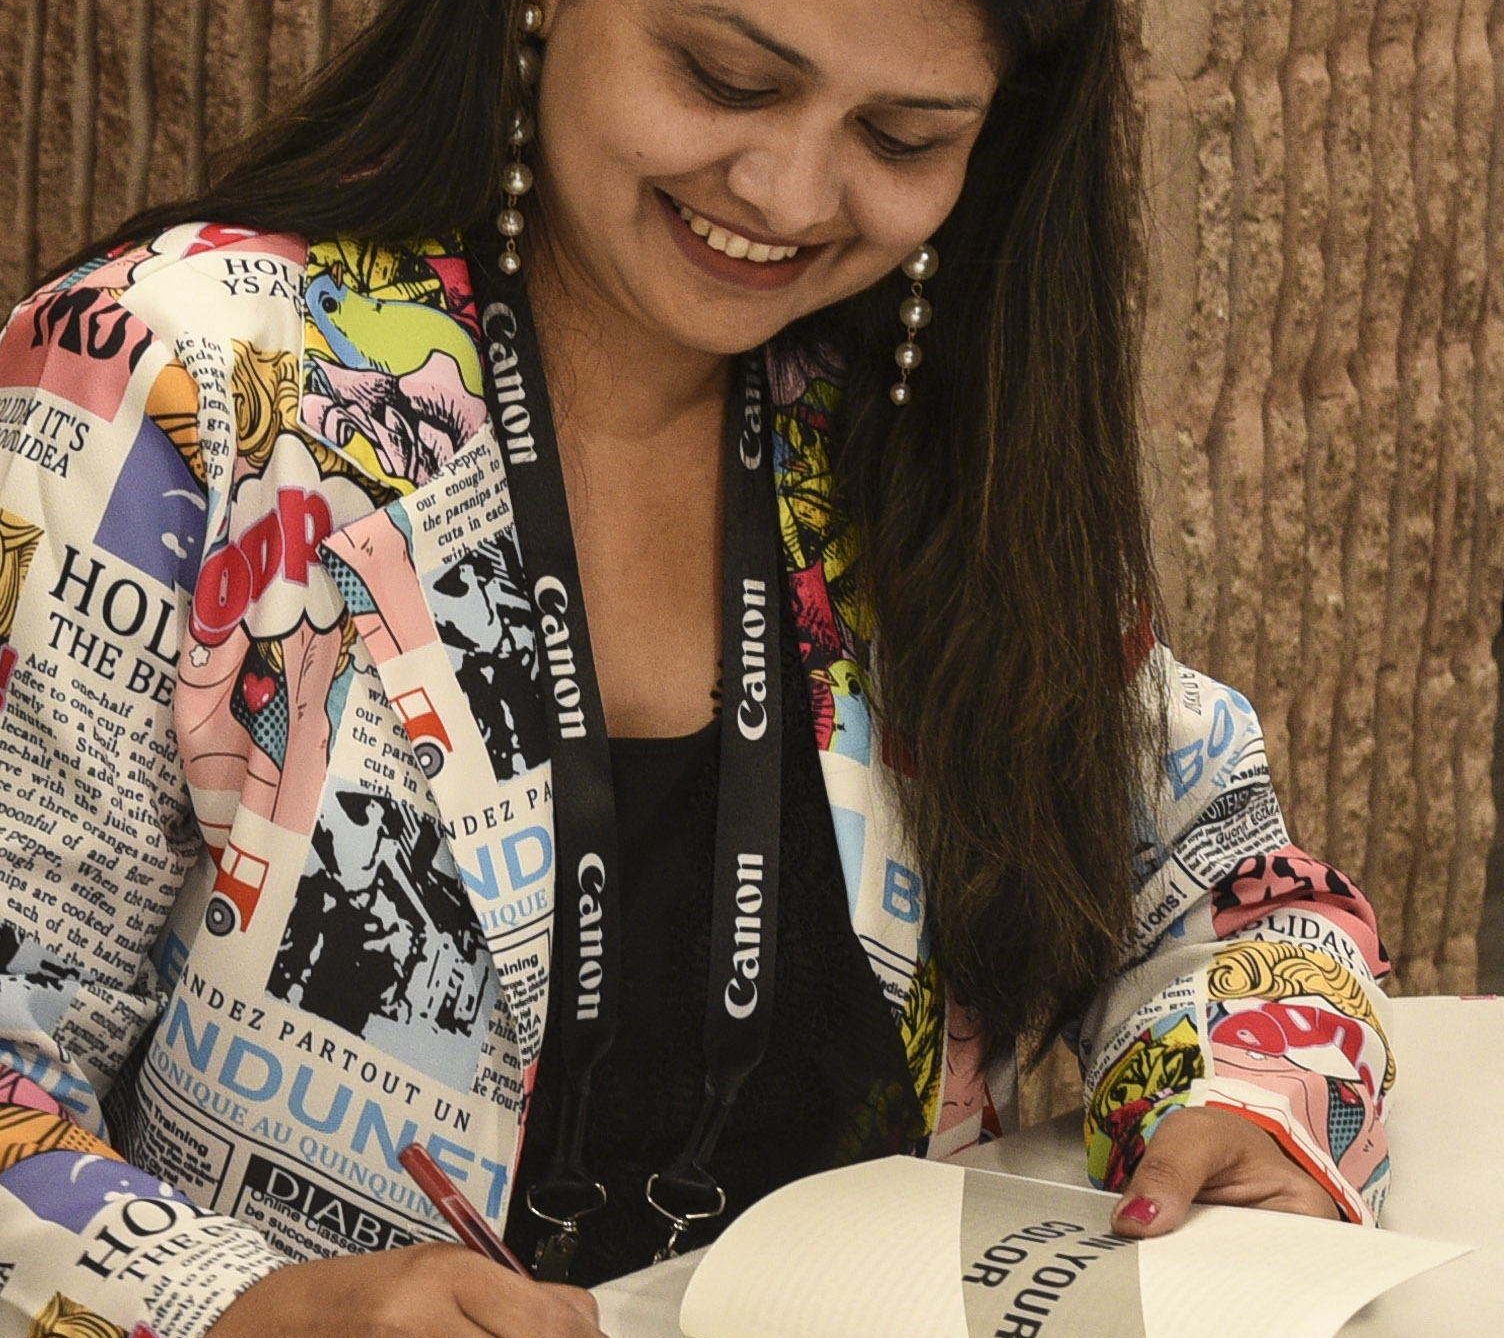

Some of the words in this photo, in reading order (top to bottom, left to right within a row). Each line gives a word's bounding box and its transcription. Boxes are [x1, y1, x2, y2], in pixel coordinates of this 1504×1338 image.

[482, 302, 538, 465] Canon
[39, 406, 90, 452] IT'S
[739, 371, 762, 470] Can
[17, 434, 71, 478] IDEA
[445, 444, 491, 475] pepper,
[445, 468, 485, 497] enough
[423, 514, 442, 532] the
[445, 488, 491, 524] parsnips
[438, 526, 464, 546] cuts
[467, 515, 482, 531] in
[486, 499, 510, 522] each
[47, 611, 119, 682] THE
[532, 575, 588, 739] Canon
[737, 578, 766, 741] Canon
[25, 653, 57, 679] Add
[71, 678, 134, 719] one-half
[144, 718, 153, 728] a
[356, 707, 382, 726] our
[50, 687, 66, 702] to
[70, 698, 94, 719] one
[97, 716, 126, 739] cup
[131, 729, 149, 744] of
[149, 739, 178, 763] cold
[53, 708, 69, 724] to
[77, 722, 85, 733] a
[93, 727, 120, 758] boil,
[129, 750, 154, 770] and
[158, 765, 178, 786] let
[352, 727, 377, 747] the
[53, 750, 81, 771] and
[87, 766, 115, 787] add
[117, 784, 144, 802] one
[58, 768, 66, 779] a
[74, 779, 103, 800] cup
[364, 757, 395, 780] cuts
[402, 771, 418, 793] in
[17, 787, 36, 802] of
[39, 796, 79, 824] three
[82, 820, 140, 859] oranges
[141, 853, 168, 873] and
[32, 772, 65, 797] with
[74, 794, 98, 815] the
[103, 811, 139, 839] juice
[145, 833, 162, 848] of
[6, 829, 62, 868] pepper,
[77, 861, 120, 896] When
[62, 833, 84, 851] of
[86, 849, 120, 871] and
[32, 887, 57, 907] are
[61, 899, 115, 938] cooked
[44, 867, 62, 884] to
[70, 882, 117, 917] stiffen
[7, 895, 39, 923] each
[46, 917, 64, 934] of
[66, 927, 90, 949] the
[576, 851, 606, 1021] Canon
[724, 852, 764, 1019] Canon
[148, 1046, 249, 1127] TONIQUE
[252, 1117, 294, 1145] AU
[278, 1021, 420, 1108] PARTOUT
[434, 1098, 472, 1133] UN
[154, 1104, 209, 1158] Training
[244, 1203, 266, 1223] be
[250, 1189, 301, 1223] Online
[305, 1215, 366, 1255] Classes
[118, 1232, 200, 1282] THE
[961, 1220, 1086, 1288] COLOR
[144, 1275, 172, 1310] Add
